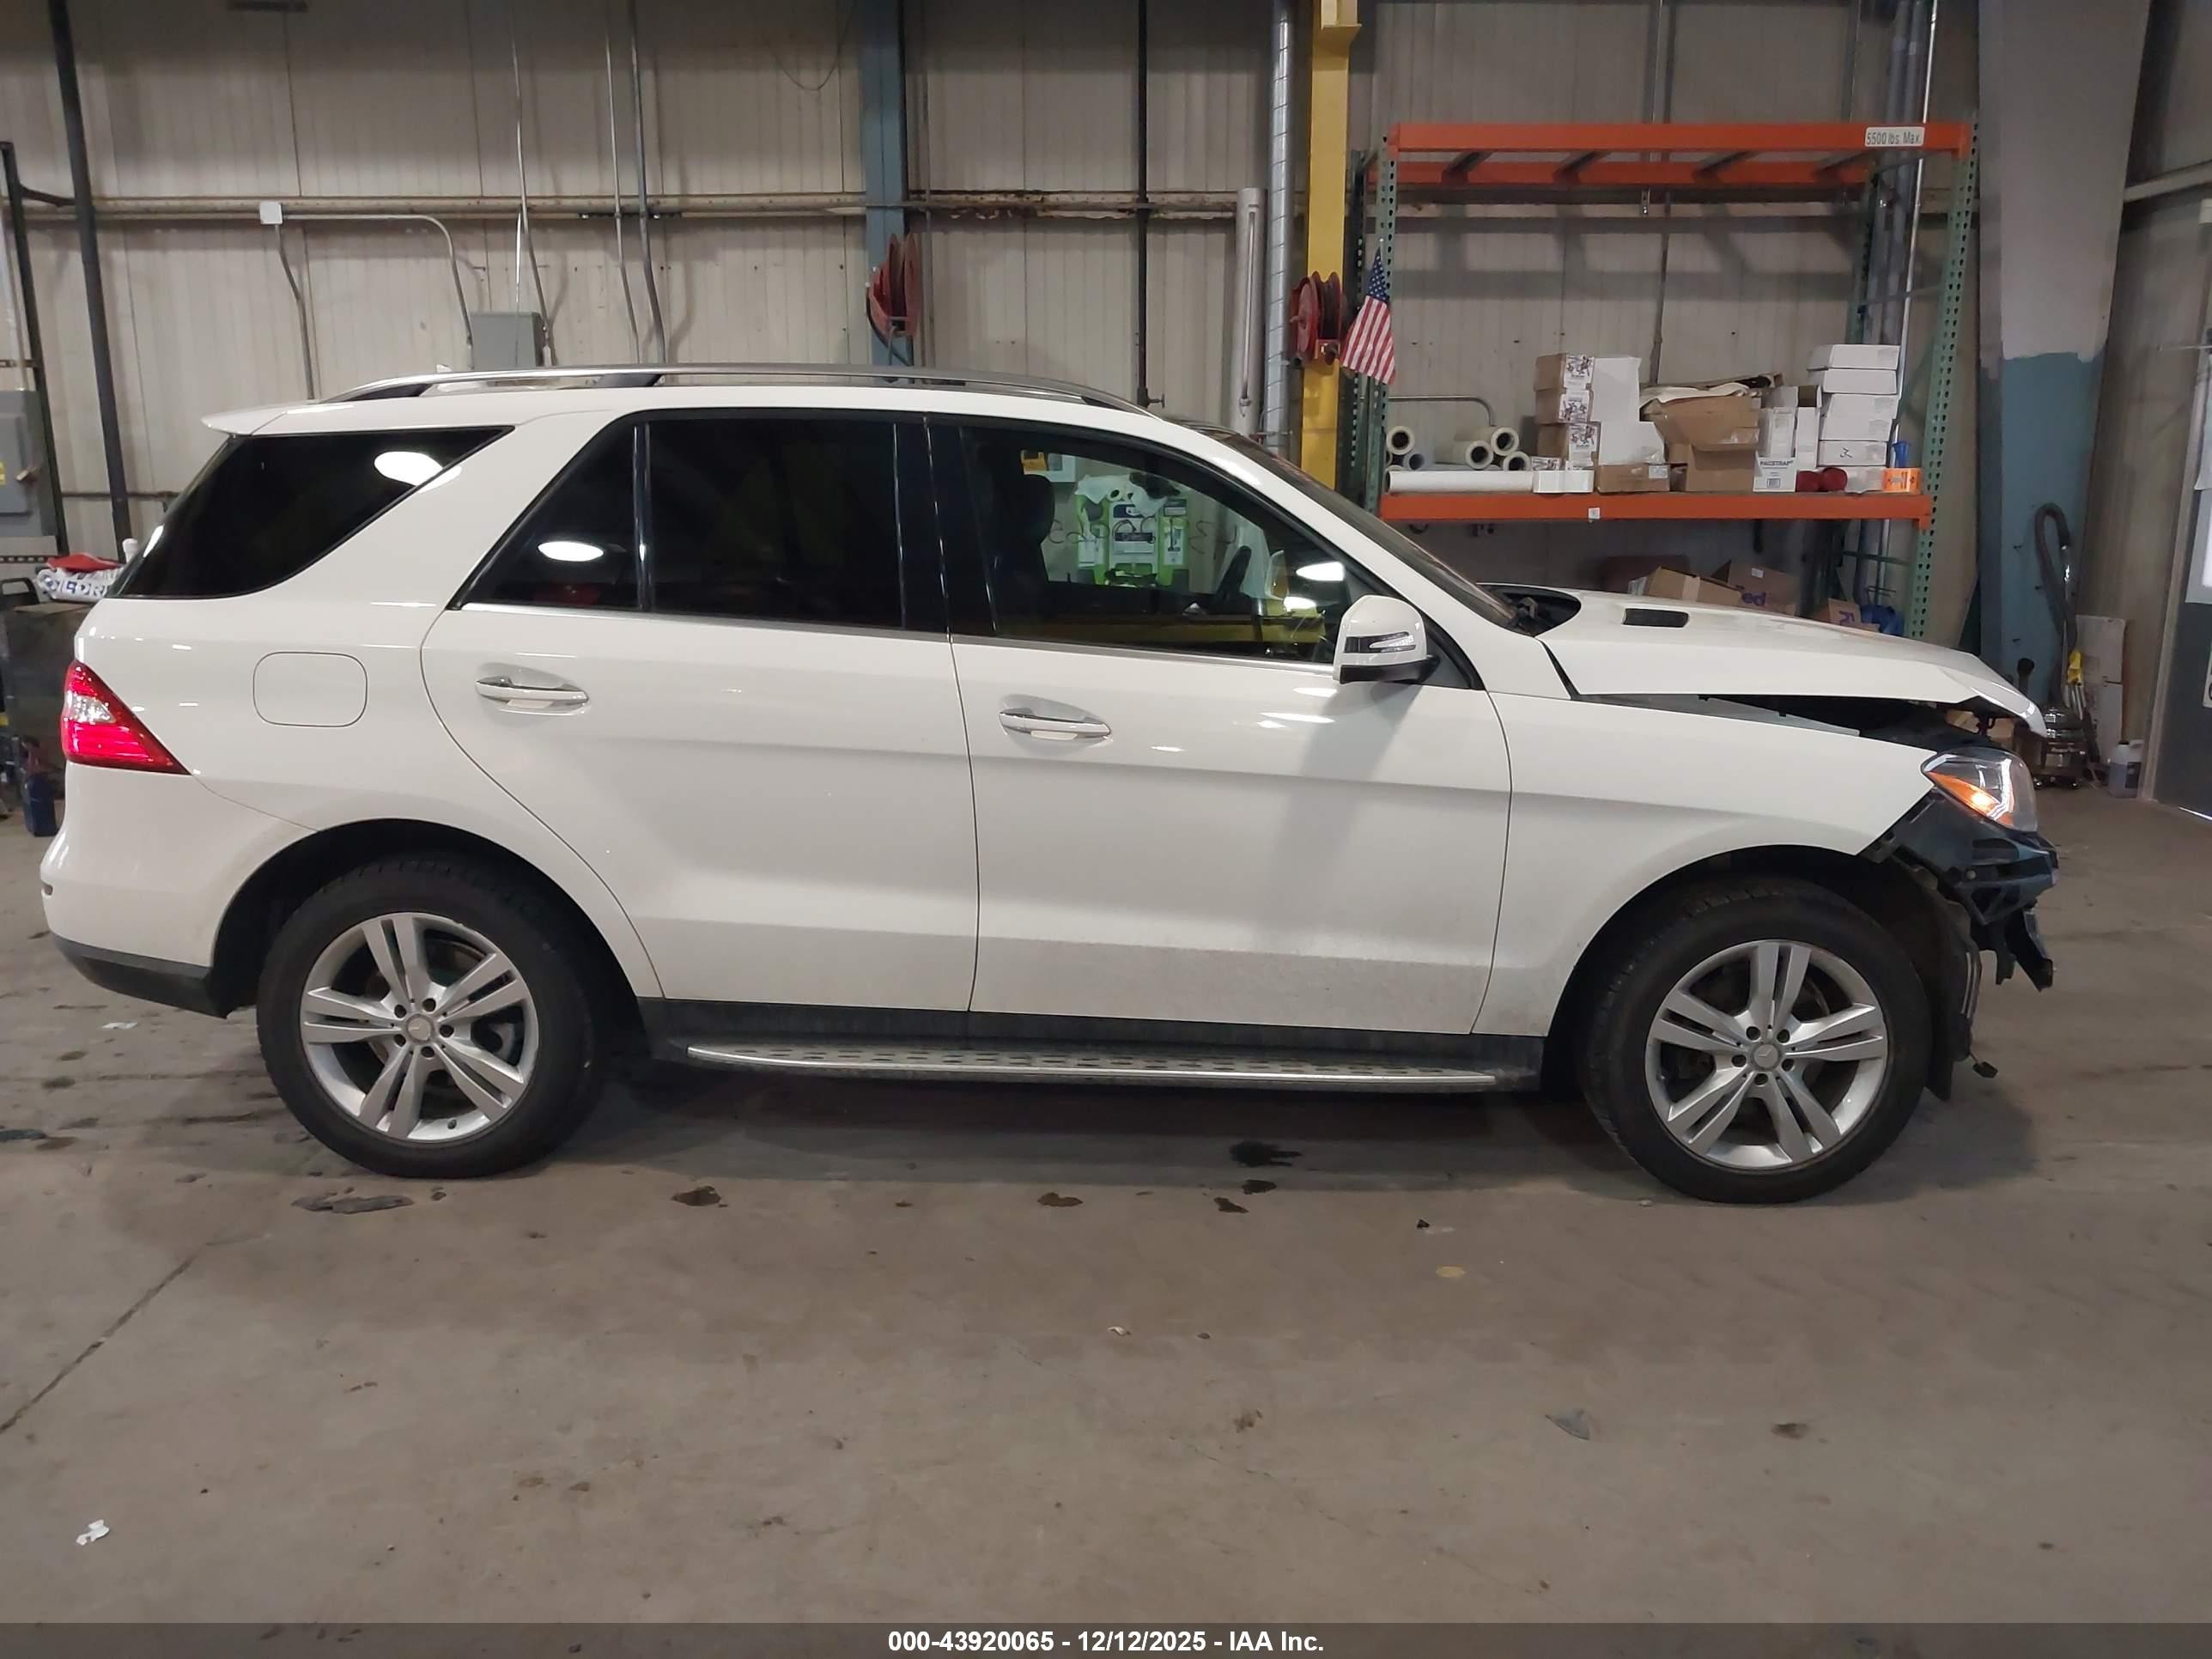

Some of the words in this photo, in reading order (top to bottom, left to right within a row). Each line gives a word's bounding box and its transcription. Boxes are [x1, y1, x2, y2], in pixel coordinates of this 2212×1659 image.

[1867, 131, 1887, 145] 5500
[1888, 131, 1900, 145] lbs
[1903, 131, 1921, 144] Max
